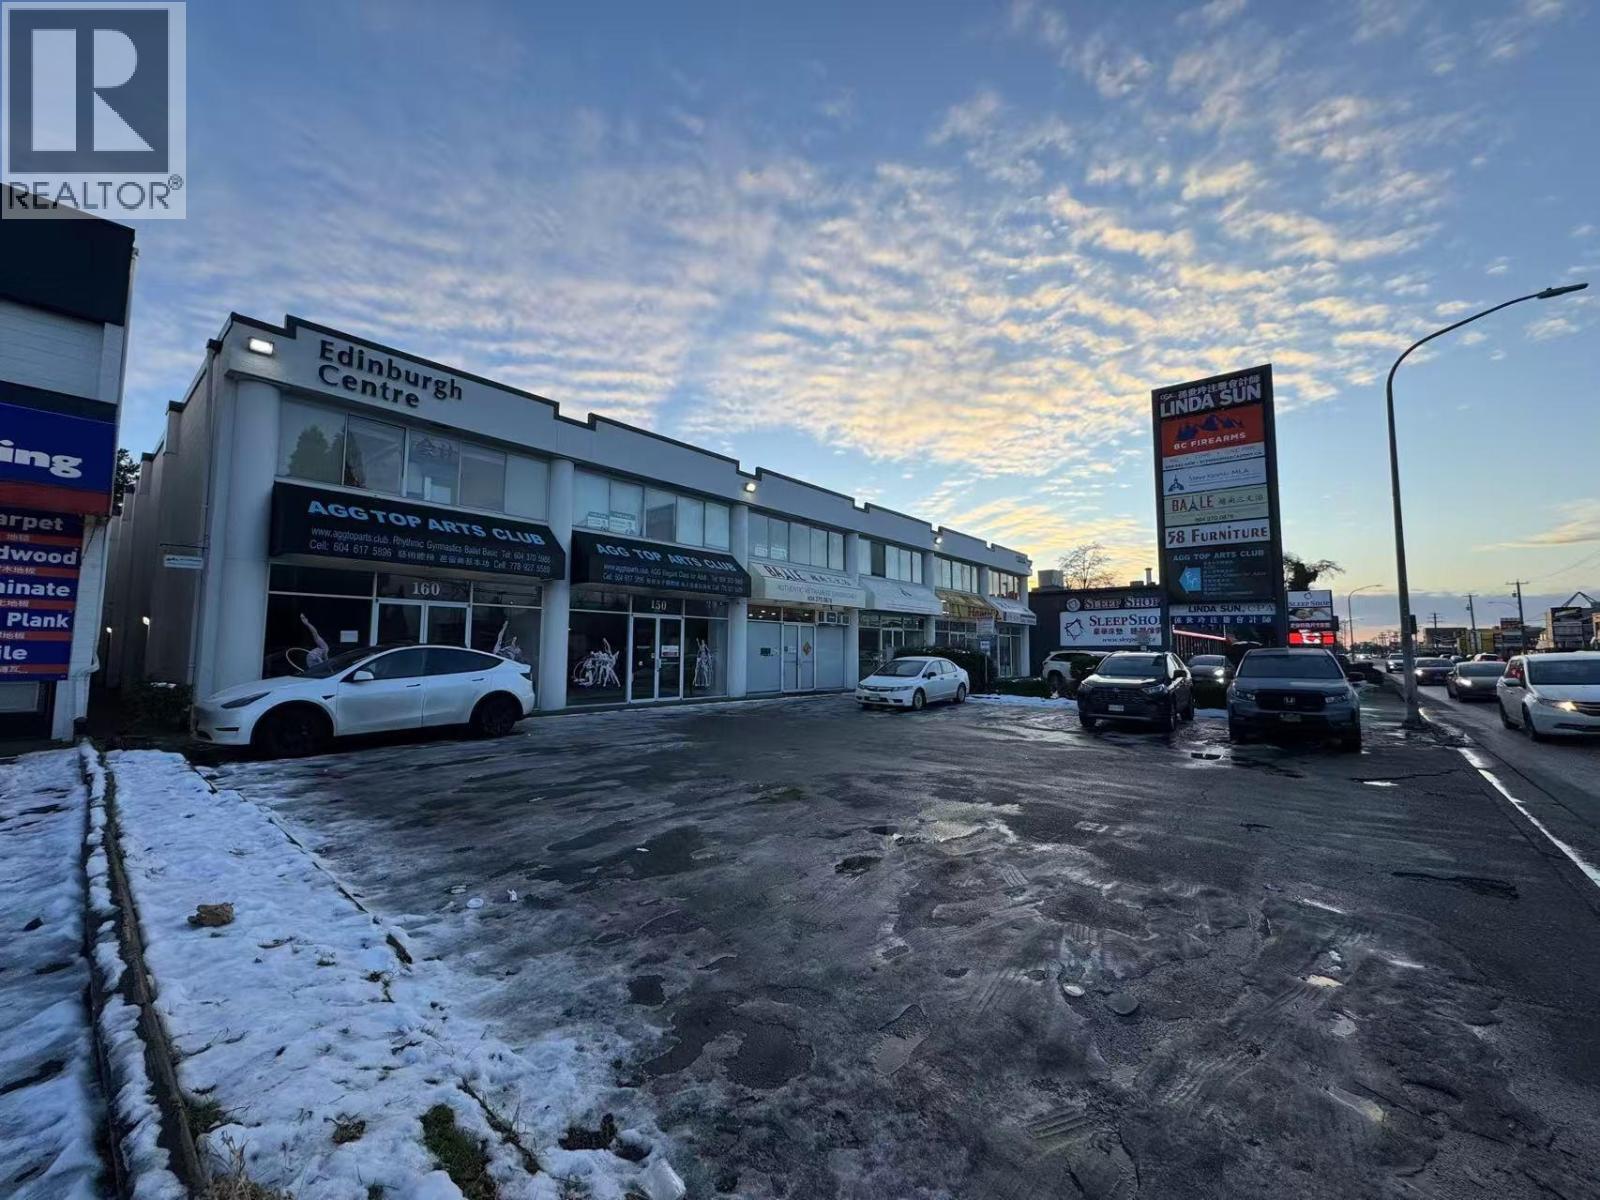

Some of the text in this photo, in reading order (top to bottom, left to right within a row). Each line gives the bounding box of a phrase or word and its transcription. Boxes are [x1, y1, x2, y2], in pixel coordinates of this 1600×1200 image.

[319, 339, 463, 400] Edinburgh
[318, 364, 420, 409] Centre
[1160, 383, 1262, 418] LINDA SUN
[1173, 432, 1247, 450] BC FIREARMS
[0, 440, 82, 478] ing
[307, 500, 546, 546] AGG TOP ARTS CLUB
[1167, 529, 1185, 545] 58
[333, 542, 349, 552] 604
[353, 544, 369, 555] 617
[1214, 551, 1237, 559] ARTS
[1239, 549, 1265, 557] CLUB
[595, 543, 737, 572] AGG TOP ARTS CLUB
[412, 582, 440, 596] 160
[650, 599, 667, 611] 150
[1124, 596, 1160, 607] SHOP
[1188, 605, 1217, 613] LINDA
[6, 612, 69, 629] Plank
